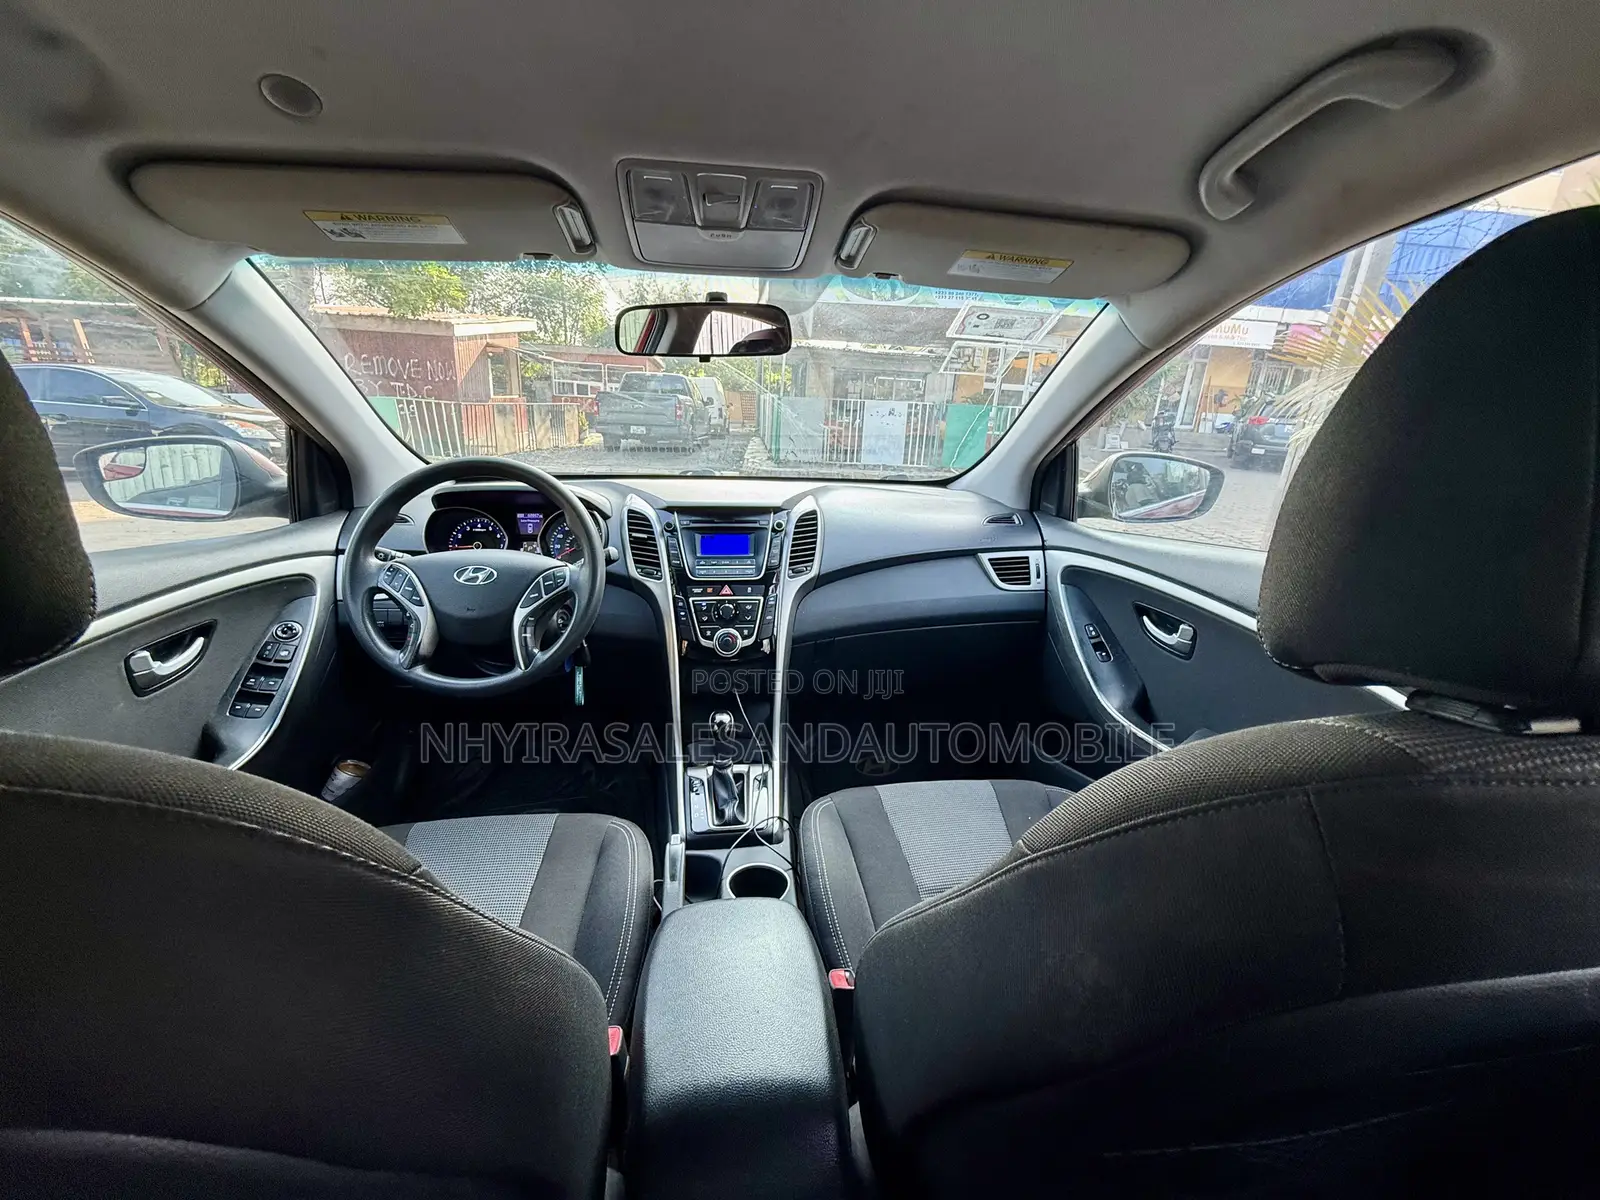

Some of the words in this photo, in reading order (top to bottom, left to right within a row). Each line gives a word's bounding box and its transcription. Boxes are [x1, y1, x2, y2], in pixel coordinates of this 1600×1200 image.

[353, 213, 421, 222] WARNING
[999, 254, 1050, 265] WARNING
[344, 352, 422, 380] REMOVE
[427, 359, 457, 381] NOW
